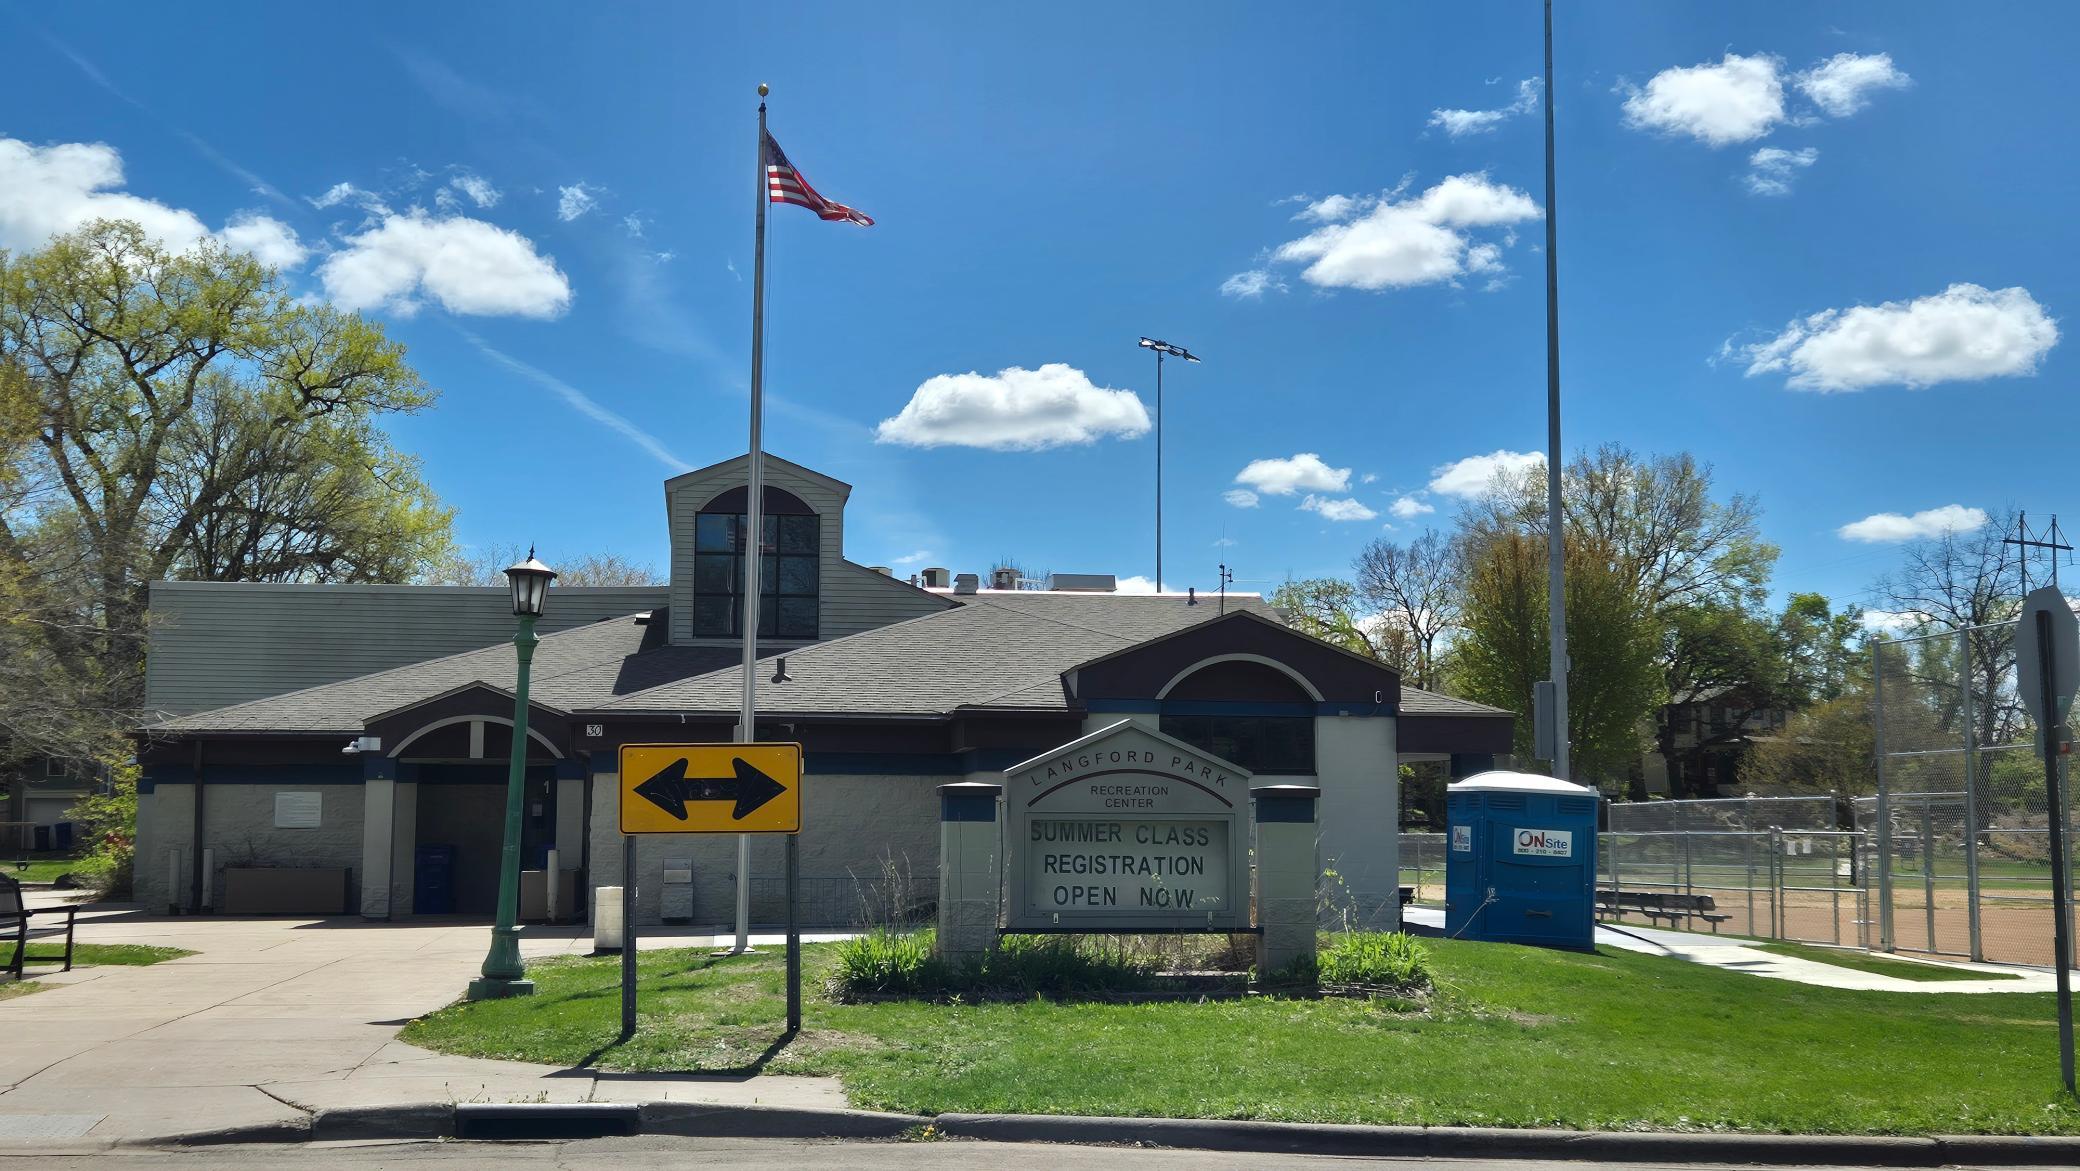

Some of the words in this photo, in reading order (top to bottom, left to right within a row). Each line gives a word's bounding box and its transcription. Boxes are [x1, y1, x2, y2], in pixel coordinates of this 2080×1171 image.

[587, 725, 602, 736] 30
[1031, 751, 1154, 787] LANGFORD
[1171, 756, 1228, 788] PARK
[1090, 785, 1169, 796] RECREATION
[1105, 798, 1154, 808] CENTER
[1031, 821, 1122, 843] SUMMER
[1135, 825, 1210, 847] CLASS
[1044, 854, 1204, 876] REGISTRATION
[1053, 885, 1117, 906] OPEN
[1140, 887, 1195, 909] NOW
